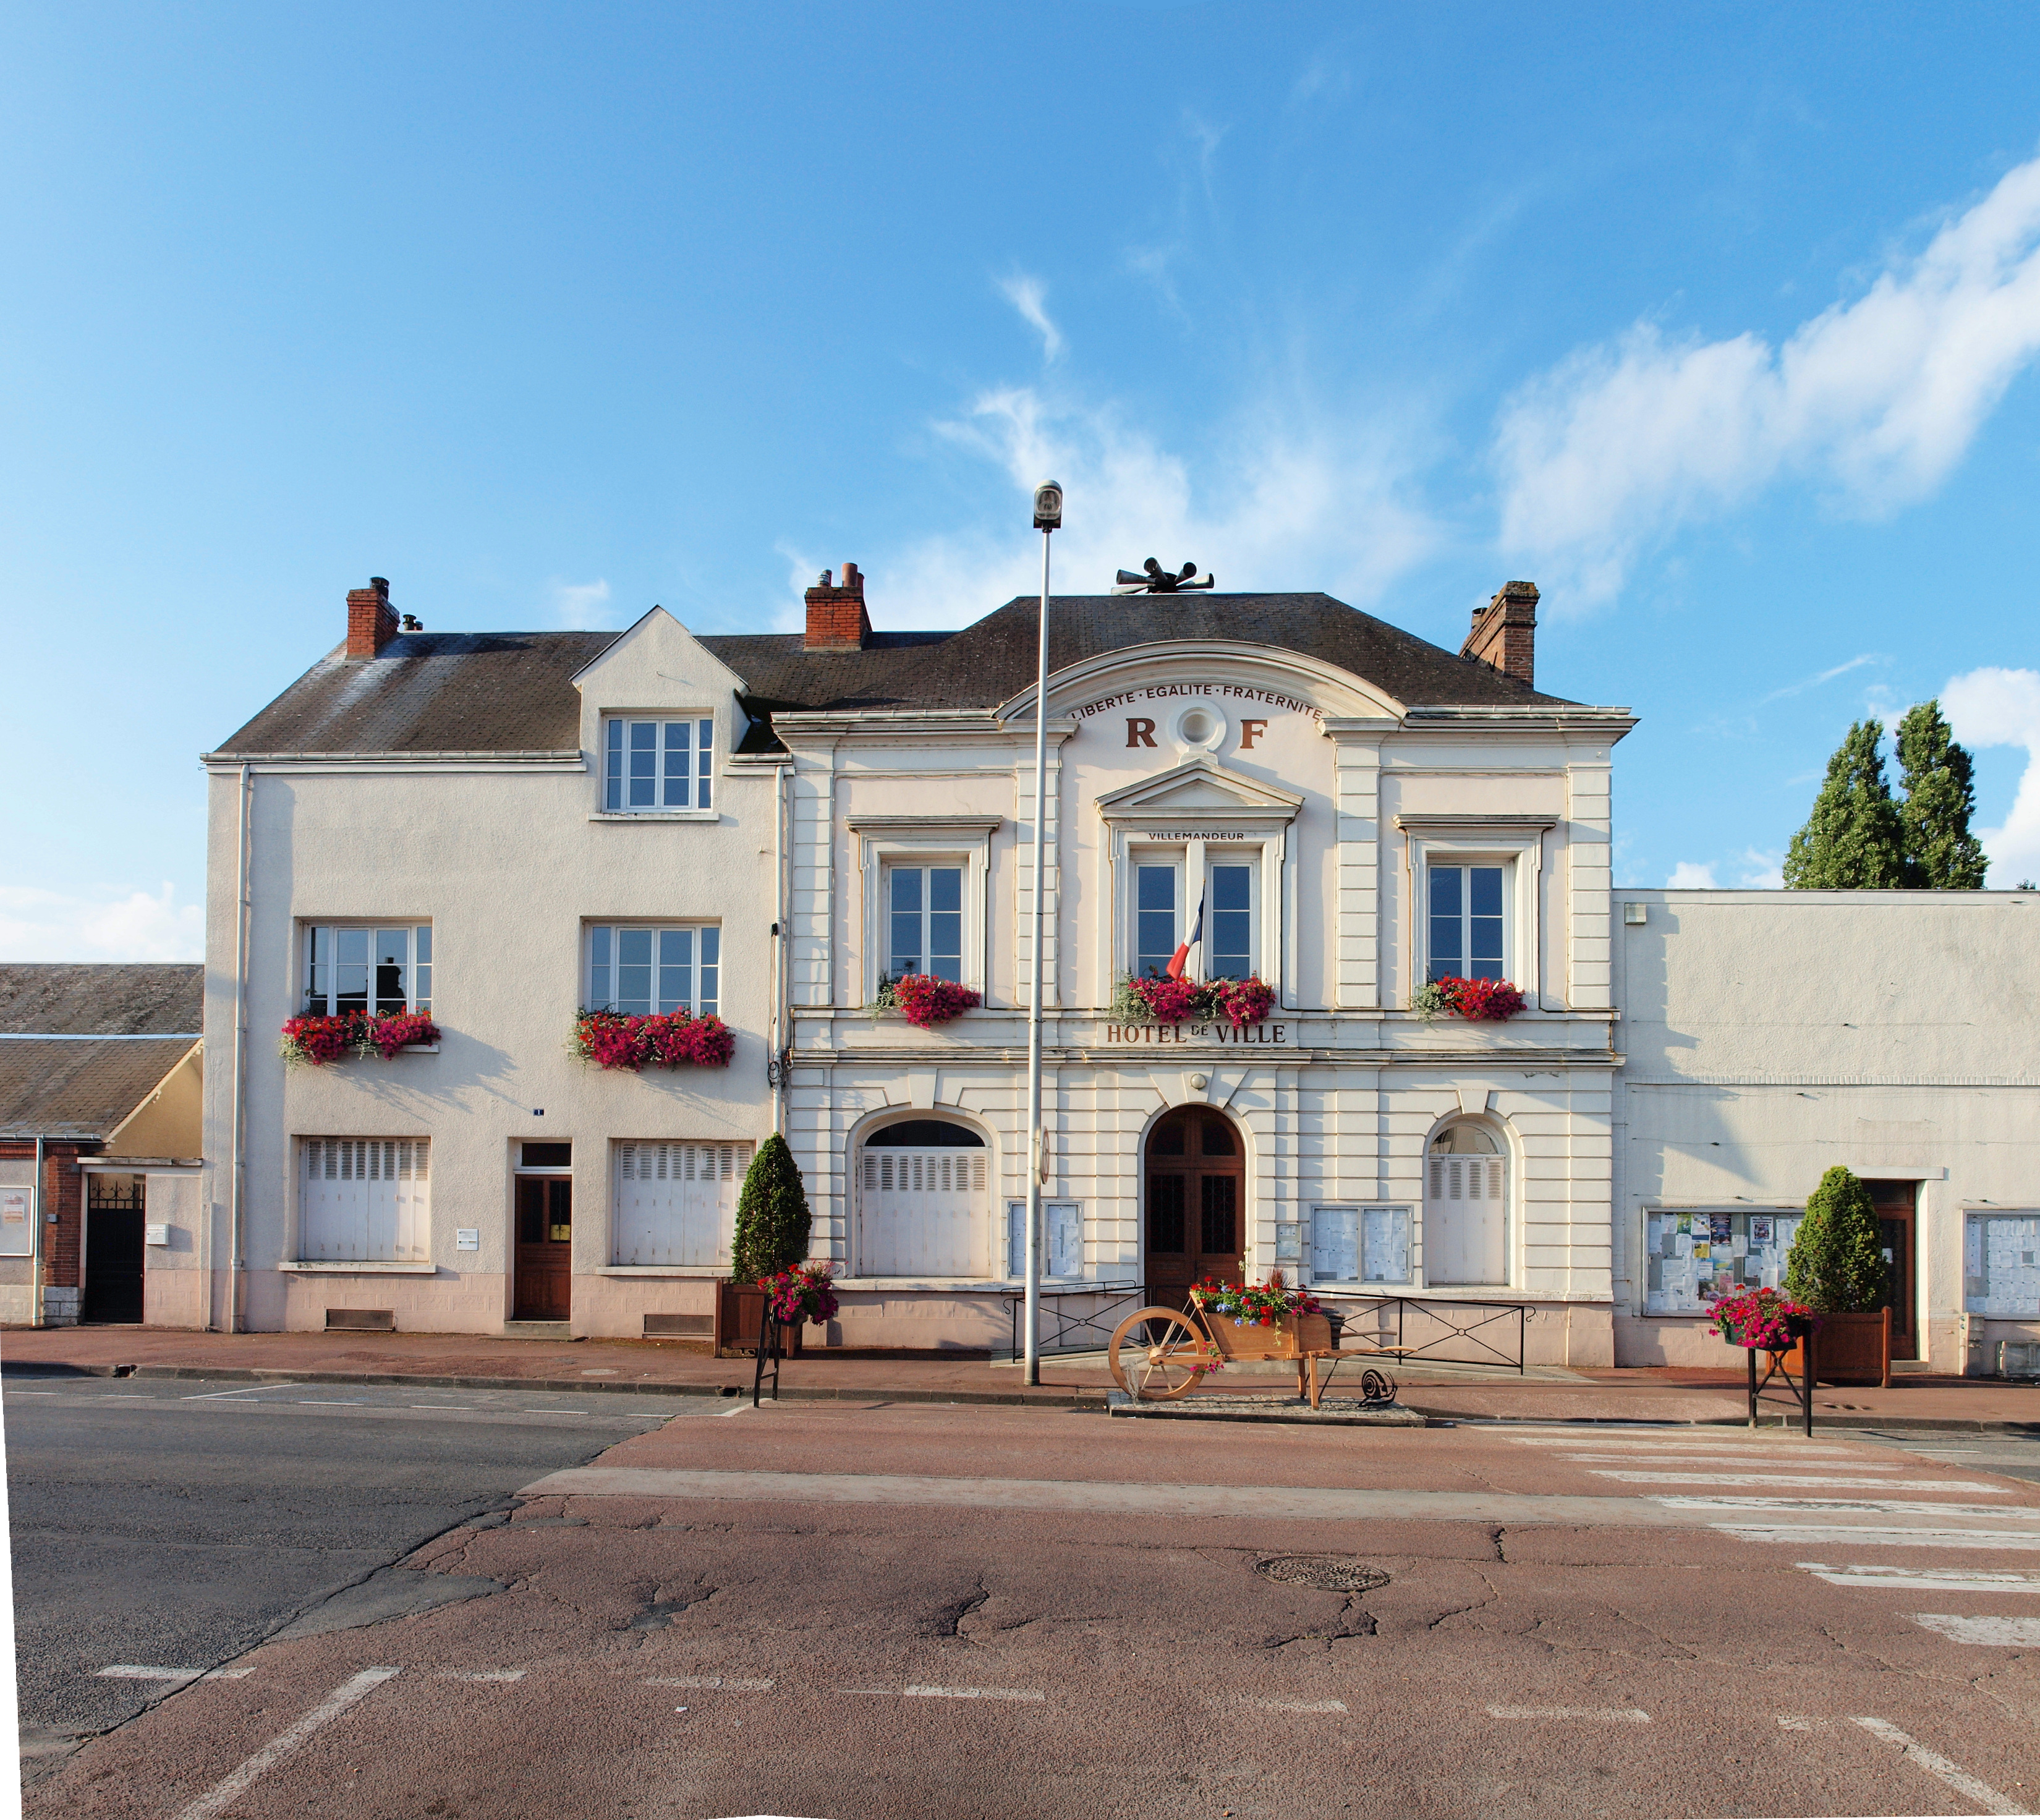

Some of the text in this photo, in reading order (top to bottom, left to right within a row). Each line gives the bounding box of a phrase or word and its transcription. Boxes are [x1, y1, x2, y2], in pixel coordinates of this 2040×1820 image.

[1071, 684, 1323, 721] LIBERTE EGALITE FRATERNITE
[1126, 718, 1268, 749] R F
[1148, 832, 1244, 841] VILLEMANDEUR
[1107, 1024, 1286, 1044] HOTEL DE VILLE
